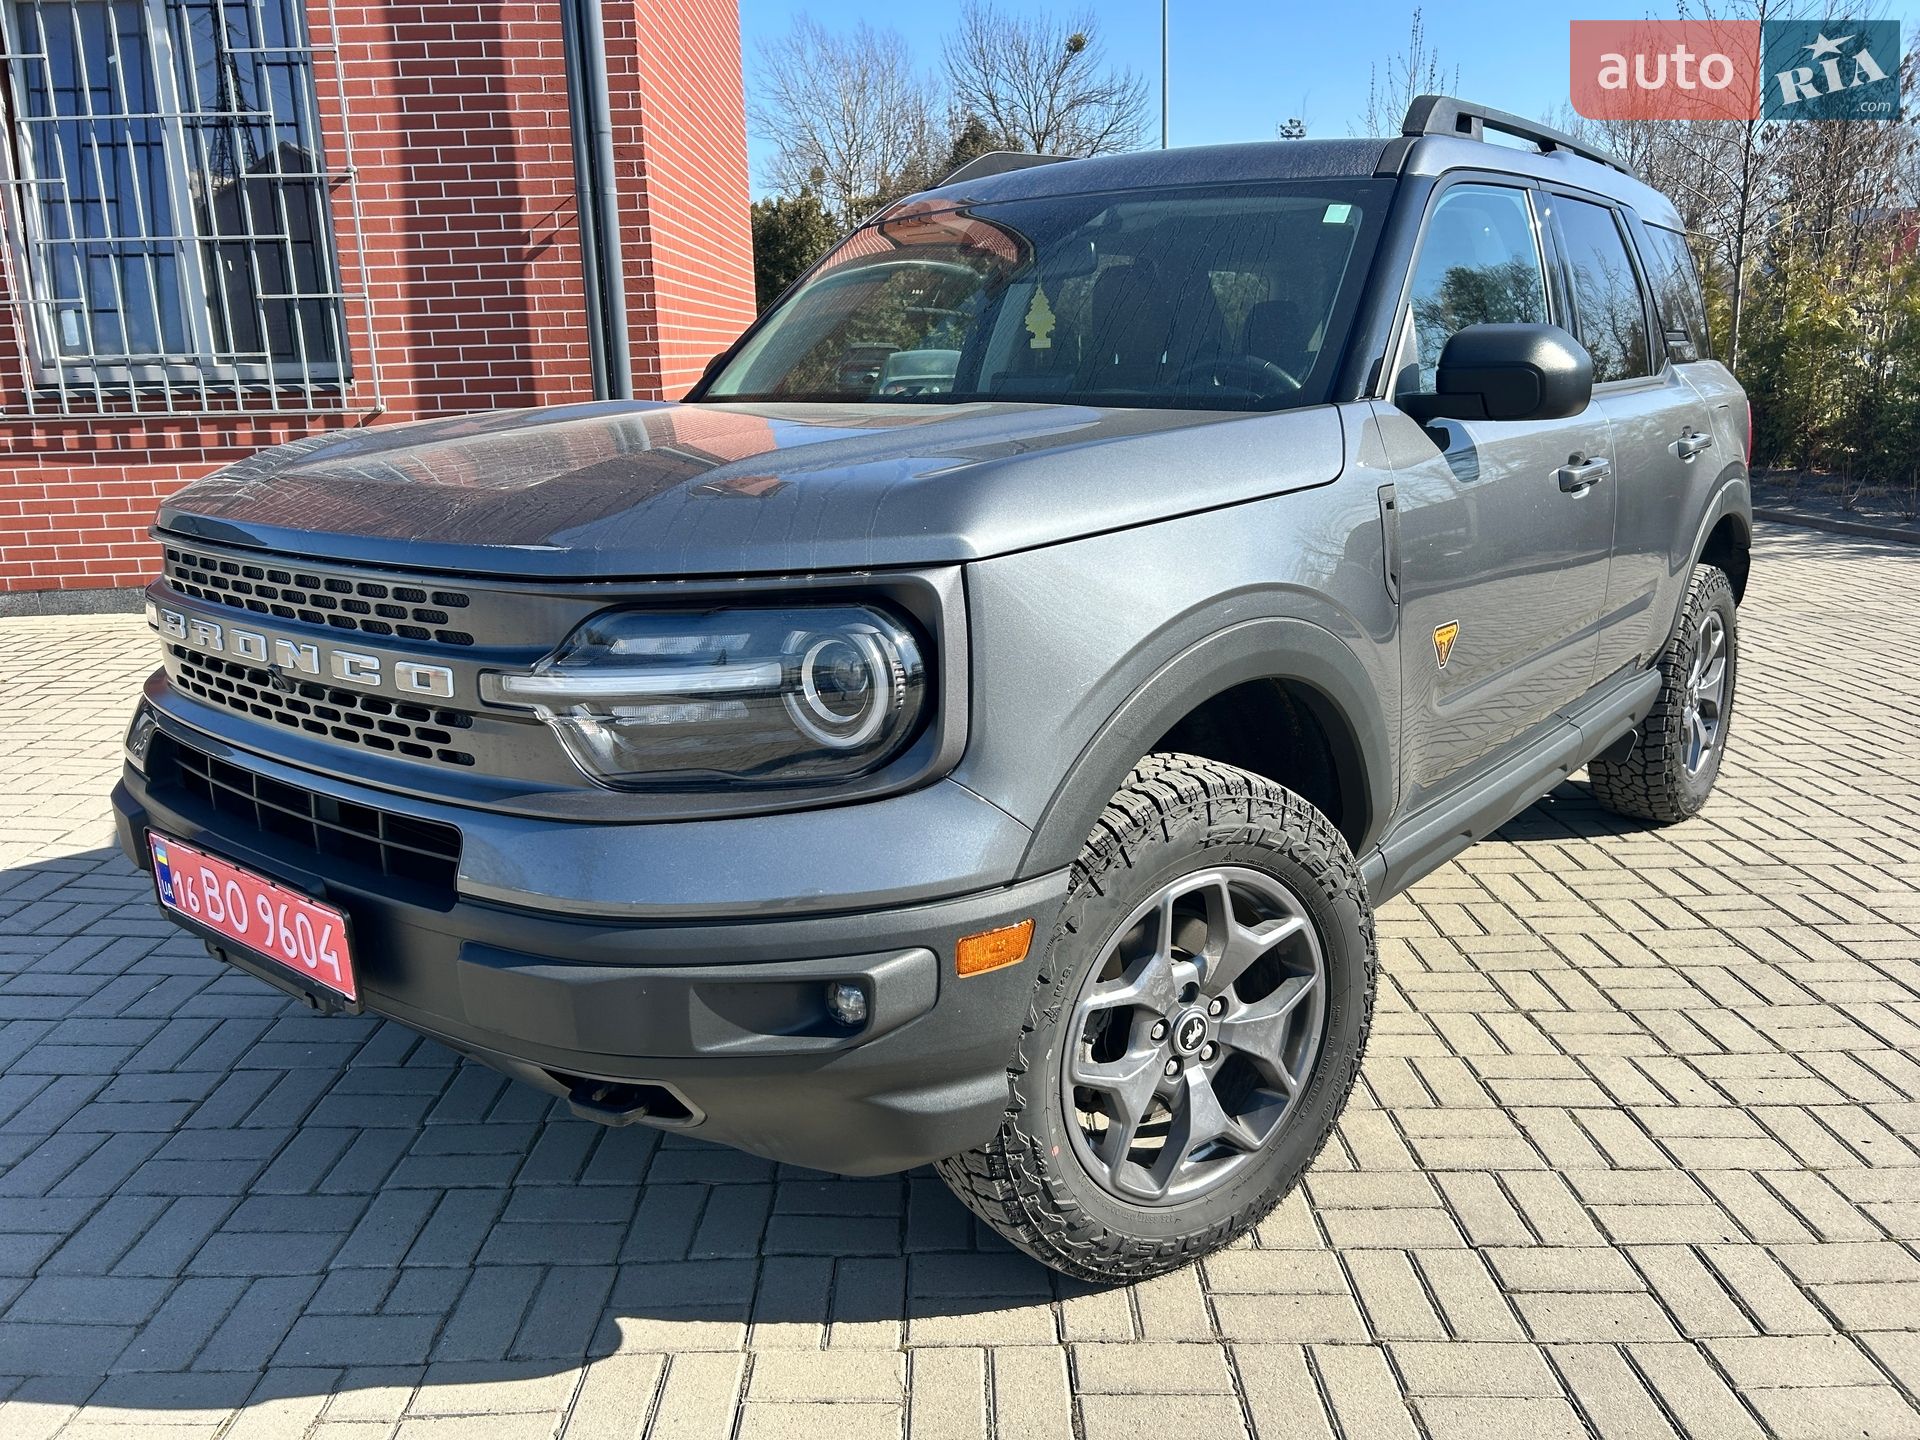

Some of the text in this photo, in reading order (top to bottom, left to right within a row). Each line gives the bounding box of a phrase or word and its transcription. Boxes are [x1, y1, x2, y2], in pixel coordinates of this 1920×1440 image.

[160, 608, 455, 698] BRONCO
[161, 880, 174, 898] UA
[173, 866, 342, 982] 16 BO 9604
